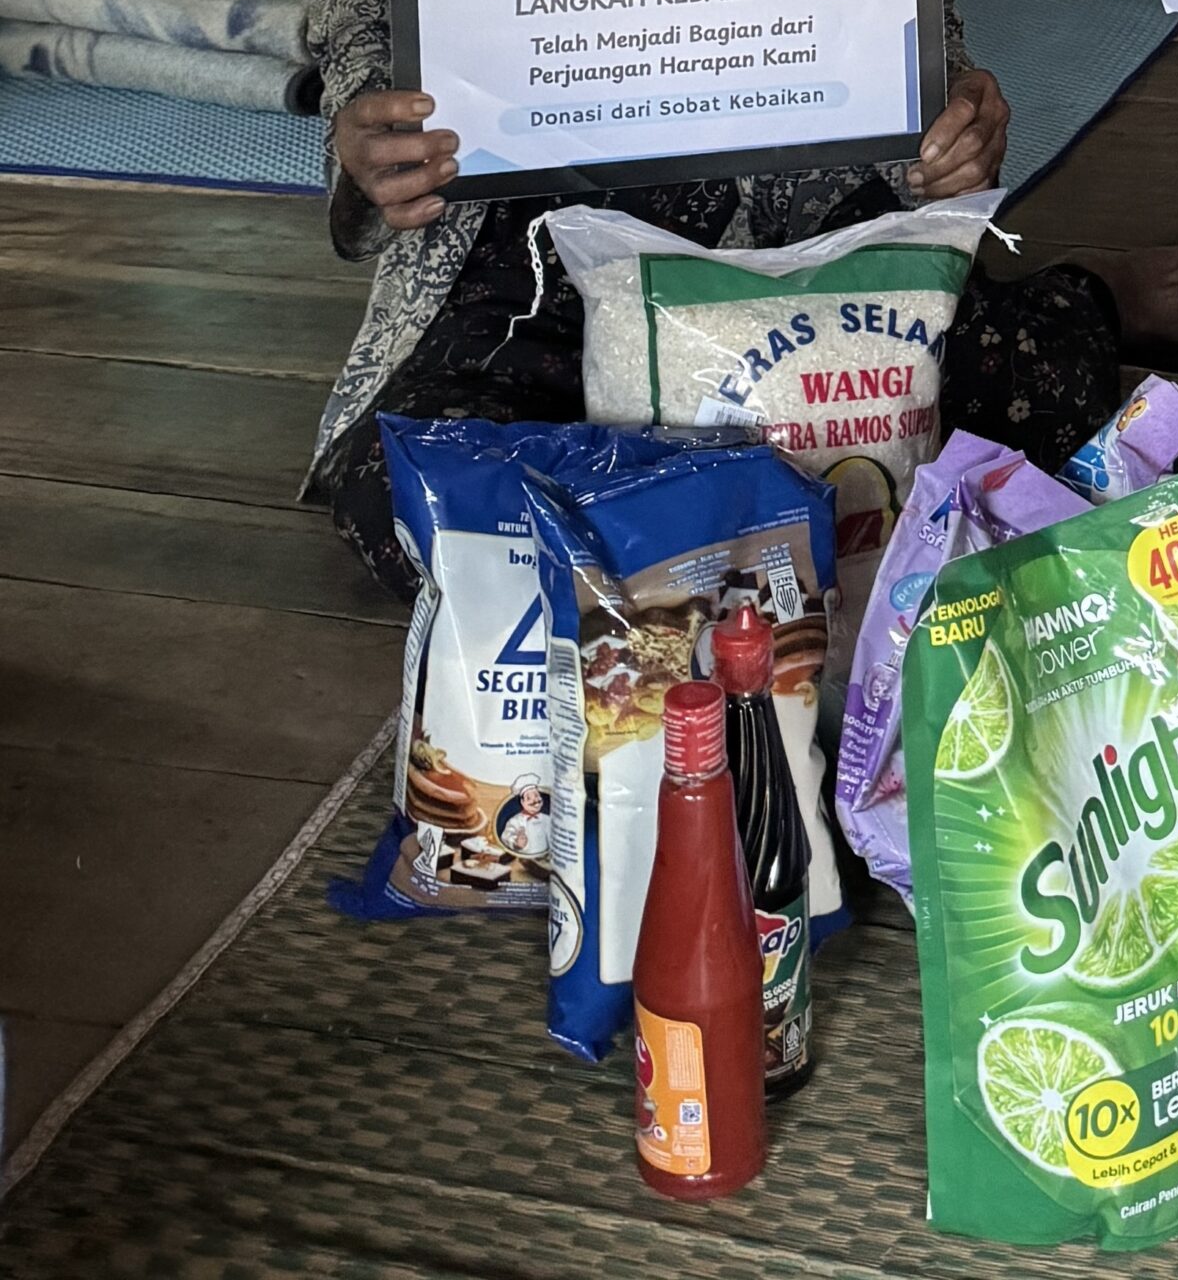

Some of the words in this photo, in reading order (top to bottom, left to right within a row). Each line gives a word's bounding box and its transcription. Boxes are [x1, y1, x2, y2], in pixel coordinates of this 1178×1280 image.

[530, 33, 588, 56] Telah
[597, 26, 681, 52] Menjadi
[689, 21, 763, 47] Bagian
[770, 15, 814, 36] dari
[529, 60, 652, 88] Perjuangan
[660, 55, 755, 76] Harapan
[763, 44, 817, 67] Kami
[530, 104, 603, 128] Donasi
[611, 100, 651, 120] dari
[659, 95, 722, 116] Sobat
[730, 88, 825, 111] Kebaikan
[718, 313, 816, 406] ERAS
[800, 365, 915, 405] WANGI
[826, 415, 893, 449] RAMOS
[930, 615, 986, 647] BARU
[476, 669, 547, 693] SEGIT
[501, 698, 549, 721] BIR
[1113, 984, 1174, 1026] JERUK
[1074, 1098, 1136, 1143] 10x
[1092, 1163, 1131, 1180] Lebih
[1133, 1147, 1168, 1173] Cepat
[1169, 1141, 1178, 1156] &
[1120, 1196, 1157, 1220] Cairan
